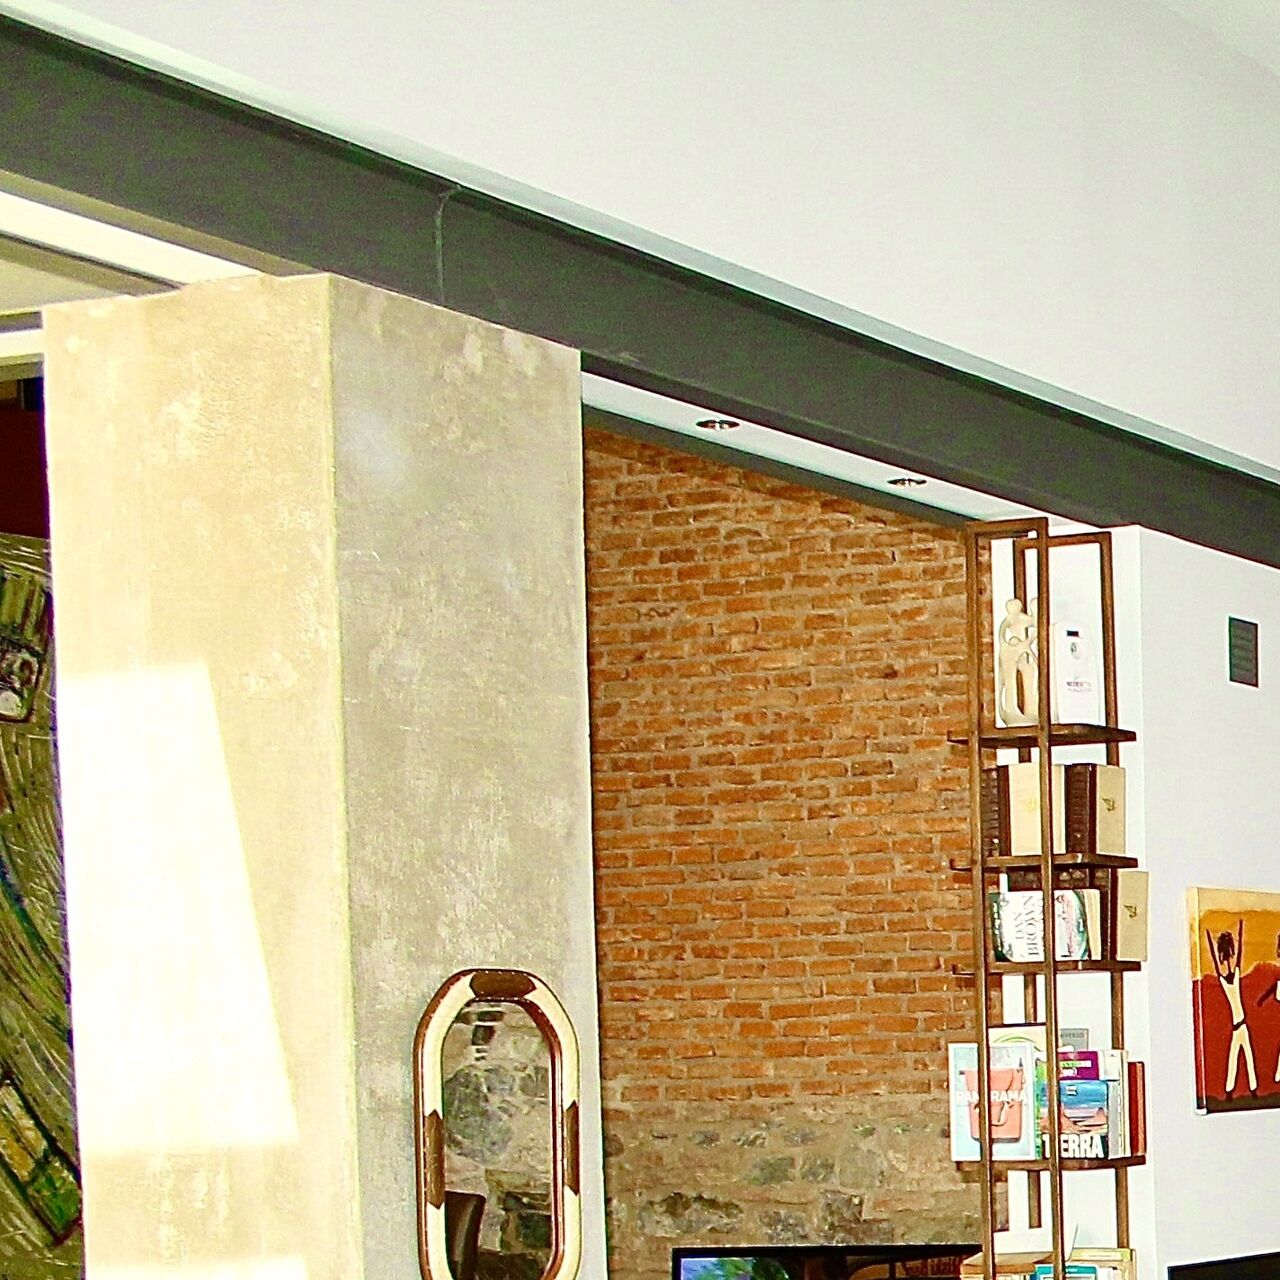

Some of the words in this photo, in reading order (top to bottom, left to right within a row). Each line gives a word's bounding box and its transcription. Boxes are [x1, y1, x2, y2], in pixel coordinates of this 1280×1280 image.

[1014, 912, 1024, 940] DAN
[1022, 896, 1039, 956] BROWN
[955, 1090, 1028, 1102] PANRAMA
[1042, 1133, 1105, 1158] TERRA
